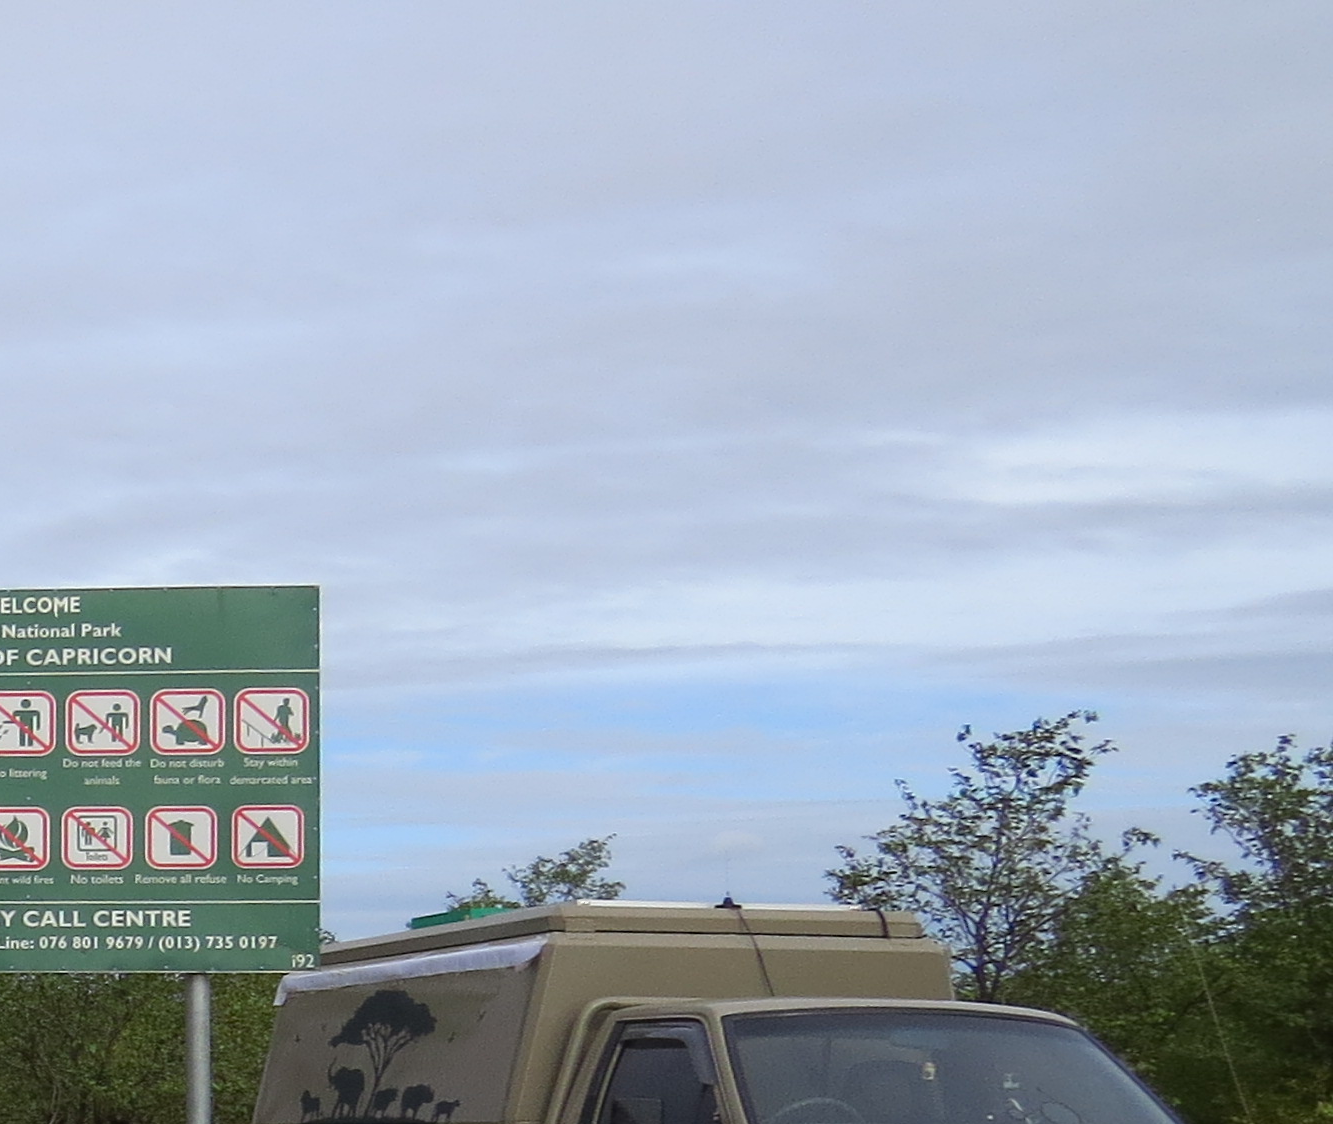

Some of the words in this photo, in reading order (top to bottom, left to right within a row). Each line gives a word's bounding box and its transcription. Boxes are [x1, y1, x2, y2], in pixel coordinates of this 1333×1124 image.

[1, 623, 75, 640] National
[81, 622, 122, 638] Park
[26, 647, 172, 666] CAPRICORN
[63, 758, 79, 768] Do
[81, 758, 99, 768] not
[101, 757, 123, 768] feed
[125, 757, 141, 768] the
[150, 758, 166, 768] Do
[168, 758, 184, 768] not
[188, 757, 224, 768] disturb
[243, 757, 264, 769] Stay
[266, 757, 298, 768] within
[9, 767, 48, 780] littering
[84, 775, 120, 785] animals
[154, 774, 179, 785] fauna
[183, 776, 195, 785] or
[198, 774, 221, 785] flora
[229, 774, 288, 785] demarcated
[11, 875, 32, 885] wild
[34, 875, 54, 885] fires
[70, 874, 87, 884] No
[90, 874, 124, 884] toilets
[135, 874, 177, 884] Remove
[180, 874, 192, 884] all
[194, 874, 227, 884] refuse
[237, 874, 253, 884] No
[255, 874, 298, 886] Camping
[23, 909, 87, 928] CALL
[93, 909, 191, 928] CENTRE
[38, 936, 67, 949] 076
[72, 936, 99, 949] 801
[106, 936, 143, 949] 9679
[147, 936, 153, 949] /
[158, 935, 200, 952] (013)
[205, 935, 233, 949] 735
[238, 935, 278, 949] 0197
[291, 953, 315, 968] i92
